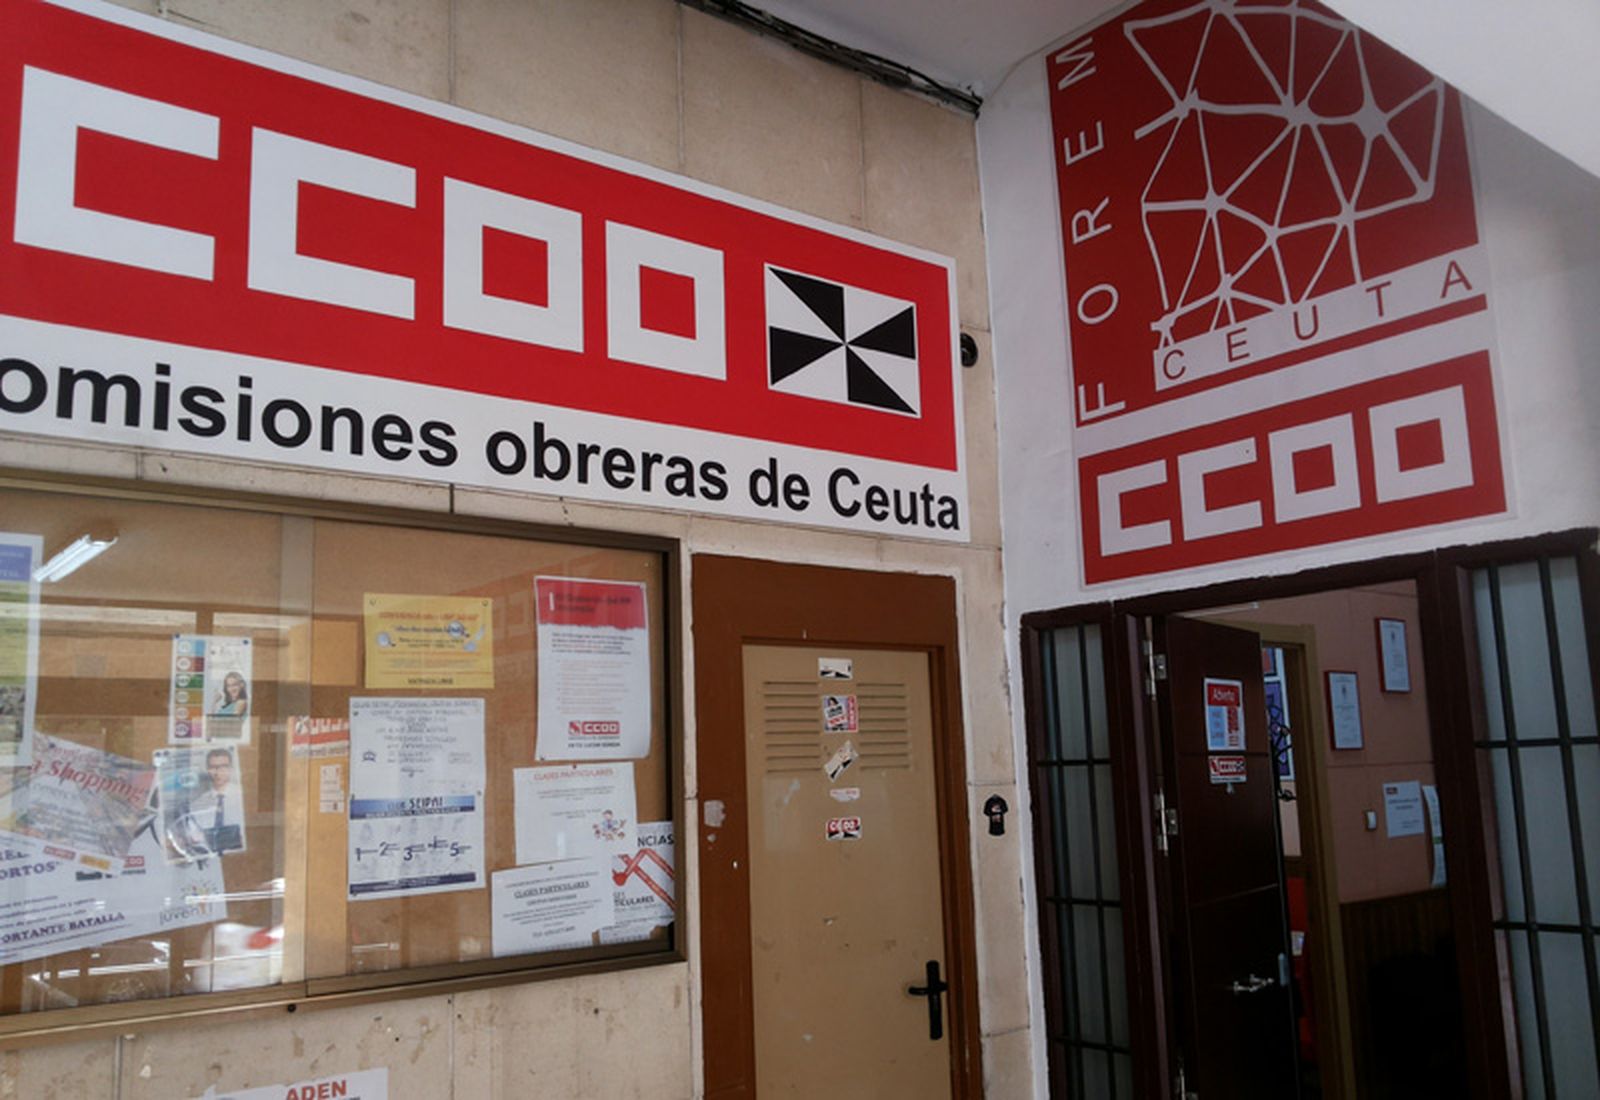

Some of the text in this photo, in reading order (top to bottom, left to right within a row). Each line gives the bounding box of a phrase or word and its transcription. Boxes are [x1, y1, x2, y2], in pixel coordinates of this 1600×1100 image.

[13, 64, 727, 381] CCOO
[1056, 37, 1126, 421] FOREM
[1162, 260, 1473, 380] CEUTA
[485, 421, 729, 502] obreras
[748, 458, 810, 511] de
[827, 468, 961, 531] Ceuta
[1097, 384, 1475, 557] CCOO
[49, 760, 145, 804] Shopping
